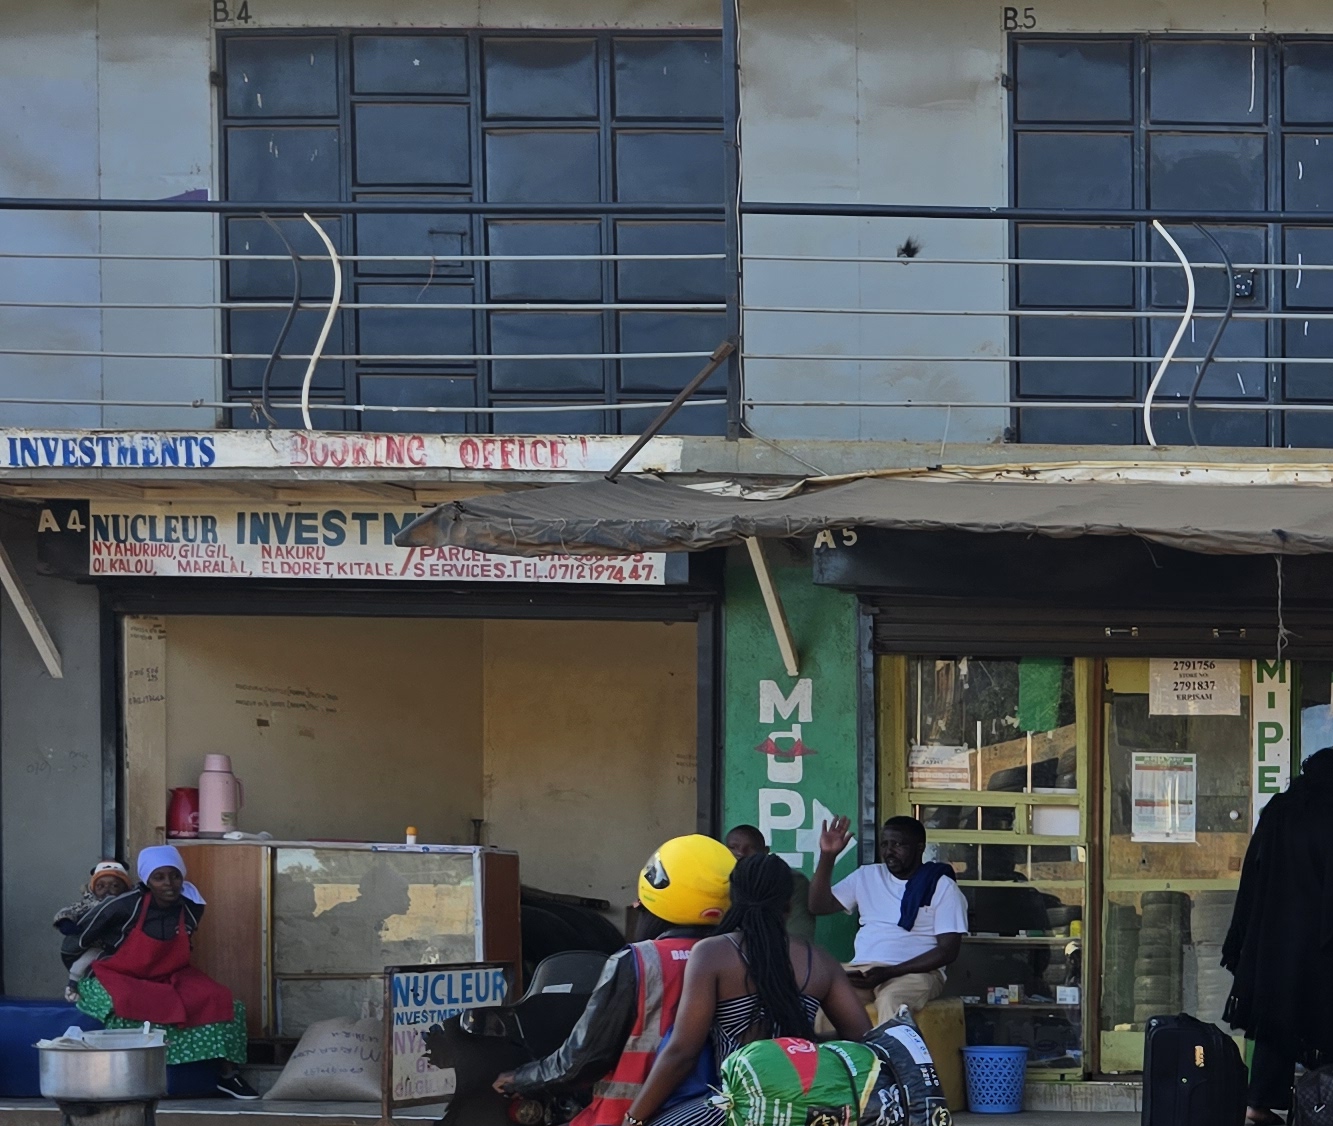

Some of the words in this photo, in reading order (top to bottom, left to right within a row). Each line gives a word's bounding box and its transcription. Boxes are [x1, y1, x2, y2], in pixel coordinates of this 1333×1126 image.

[8, 436, 216, 467] INVESTMENTS
[92, 514, 218, 544] NUCLEUR
[237, 510, 424, 546] INVESTM
[261, 545, 326, 561] NAKURU
[420, 547, 492, 562] PARCEL
[1173, 661, 1216, 671] 2791756
[1173, 681, 1216, 691] 2791837
[393, 970, 505, 1008] NUCLEUR
